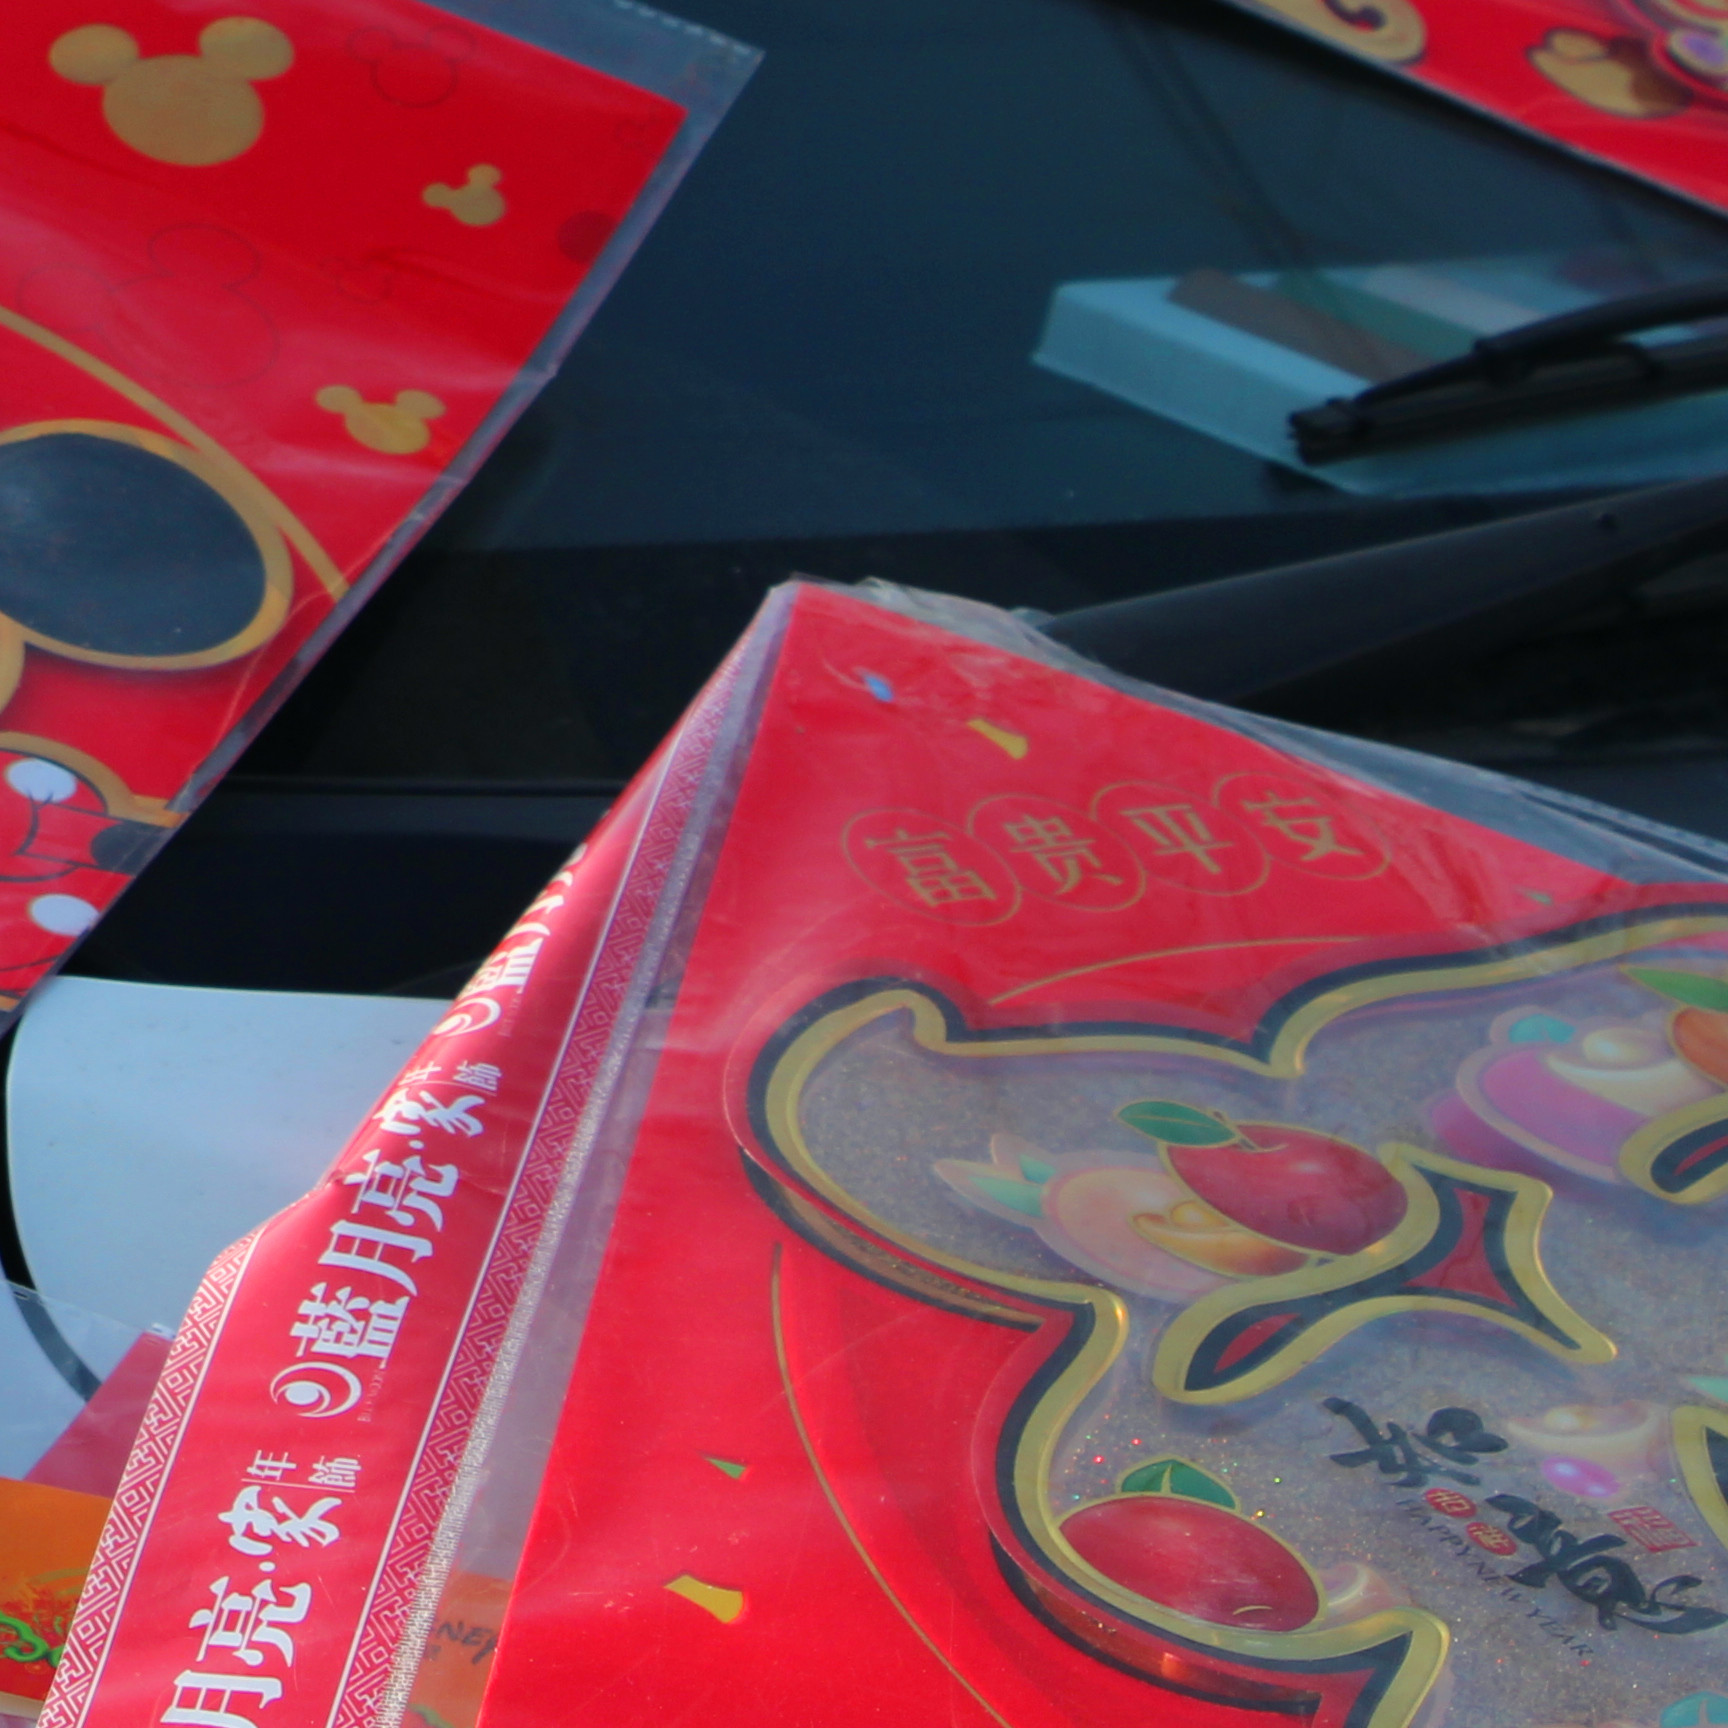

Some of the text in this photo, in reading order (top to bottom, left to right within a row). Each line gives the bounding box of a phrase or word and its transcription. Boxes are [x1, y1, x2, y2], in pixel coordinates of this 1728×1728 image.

[864, 788, 1362, 908] 富贵平安
[1397, 1498, 1594, 1657] HAPPY NEW YEAR
